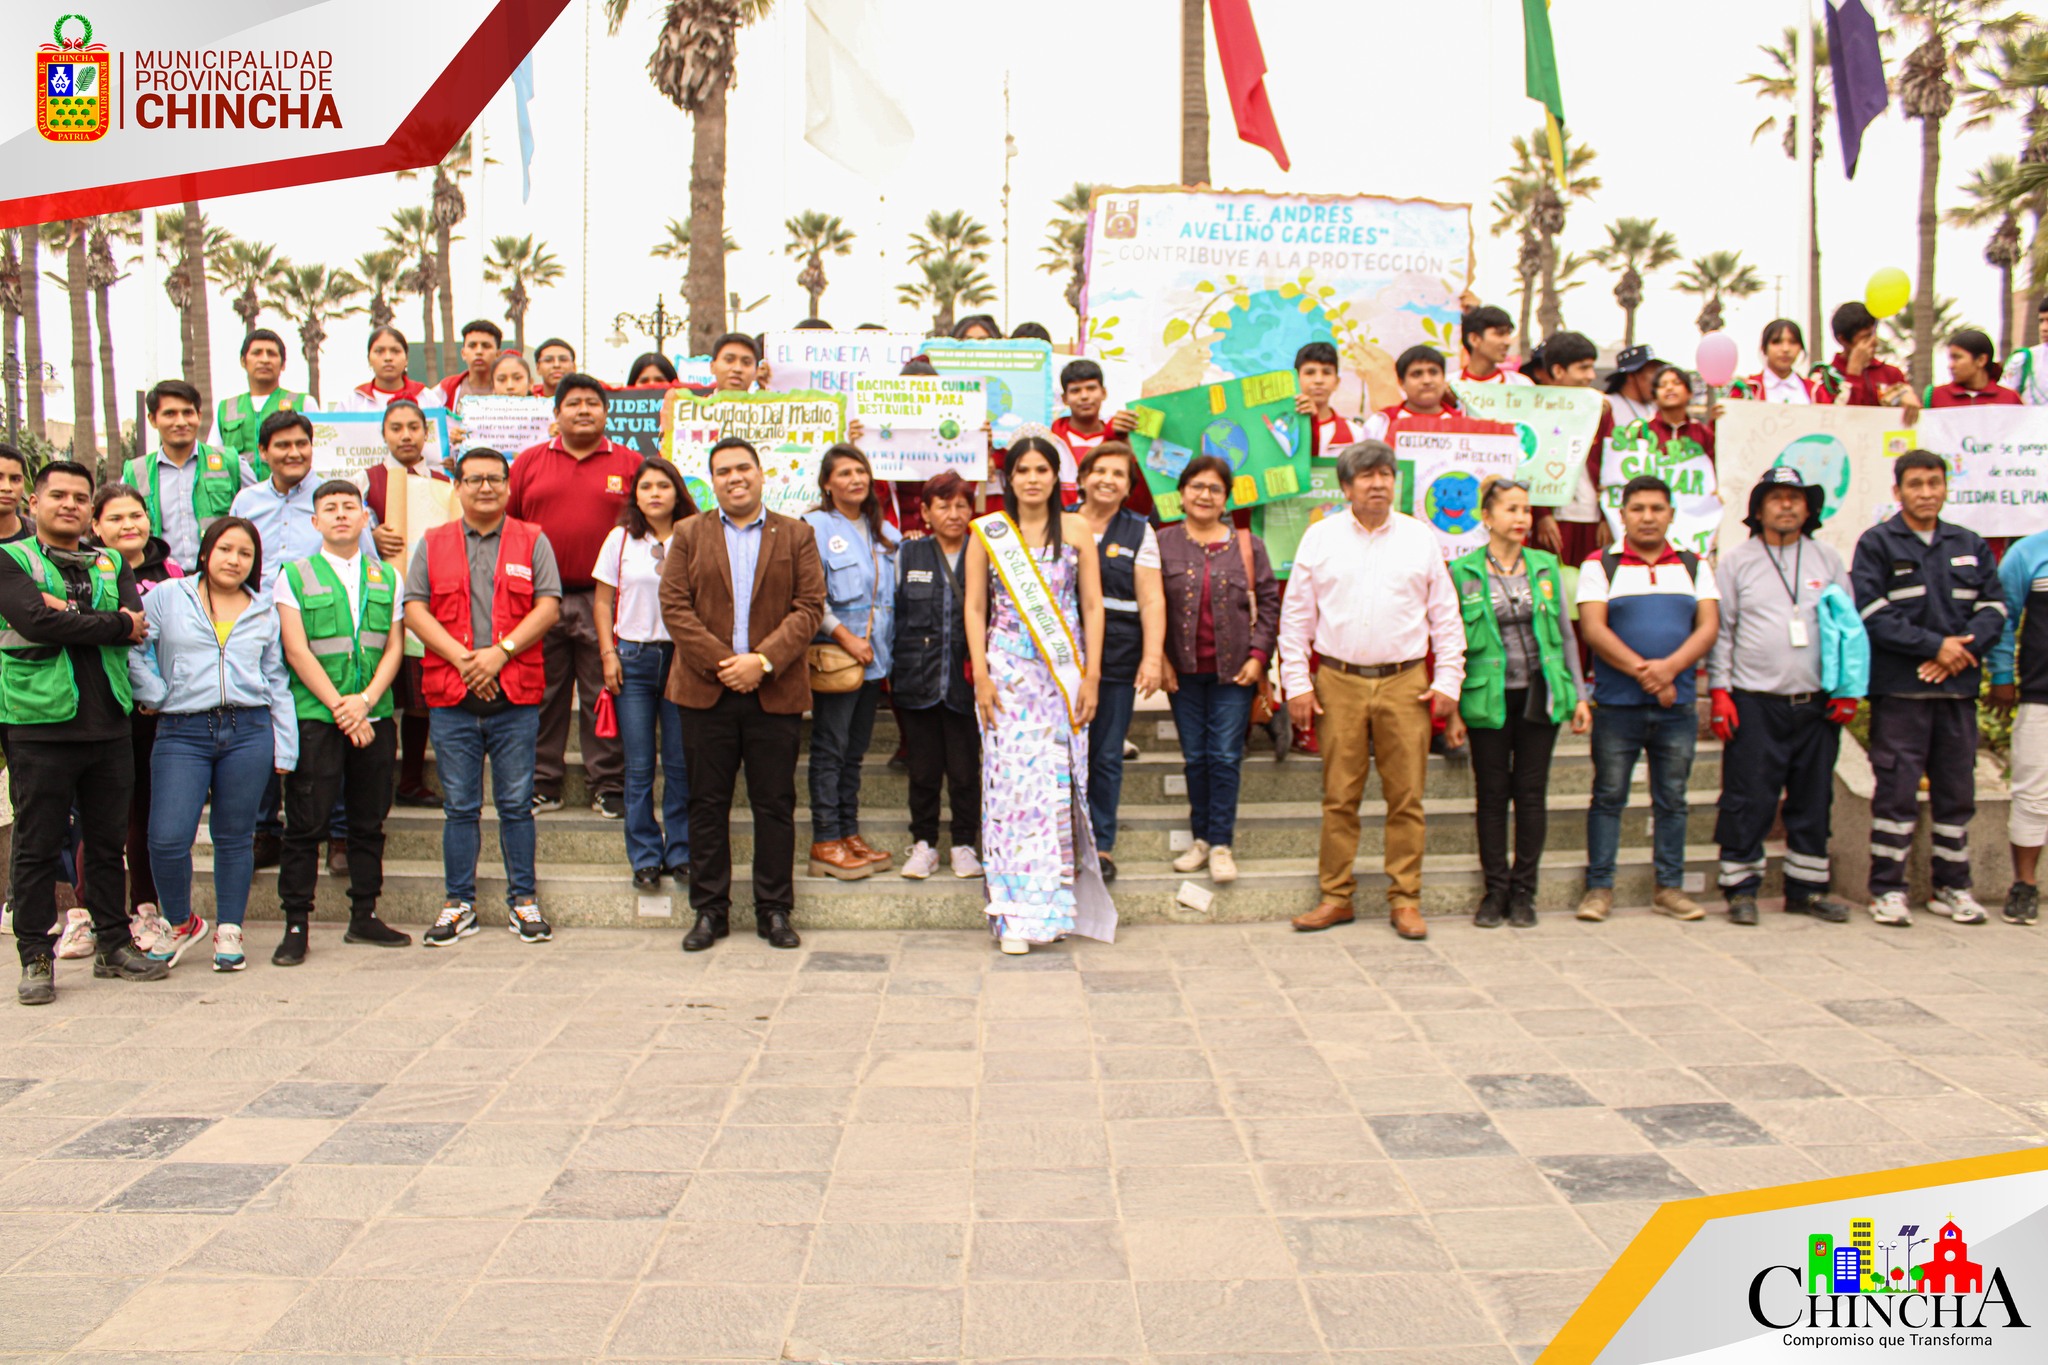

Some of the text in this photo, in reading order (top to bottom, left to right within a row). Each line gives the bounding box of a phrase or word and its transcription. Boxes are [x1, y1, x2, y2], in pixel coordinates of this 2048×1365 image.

[1179, 221, 1275, 243] AVELINO
[1119, 244, 1250, 267] CONTRIBUYE
[1256, 250, 1269, 268] A
[1276, 251, 1301, 269] LA
[778, 344, 793, 363] EL
[805, 345, 871, 363] PLANETA
[810, 370, 867, 392] MEREC
[856, 379, 981, 393] NACIMOS PARA CUIDAR
[935, 393, 964, 406] PARA
[678, 401, 832, 425] El Cuidado Del Medio
[858, 403, 923, 416] DESTRUIRLO
[720, 419, 785, 440] Ambiente
[335, 445, 389, 457] EL CUIDADO
[2000, 489, 2020, 505] EL
[2022, 489, 2048, 504] PLAN
